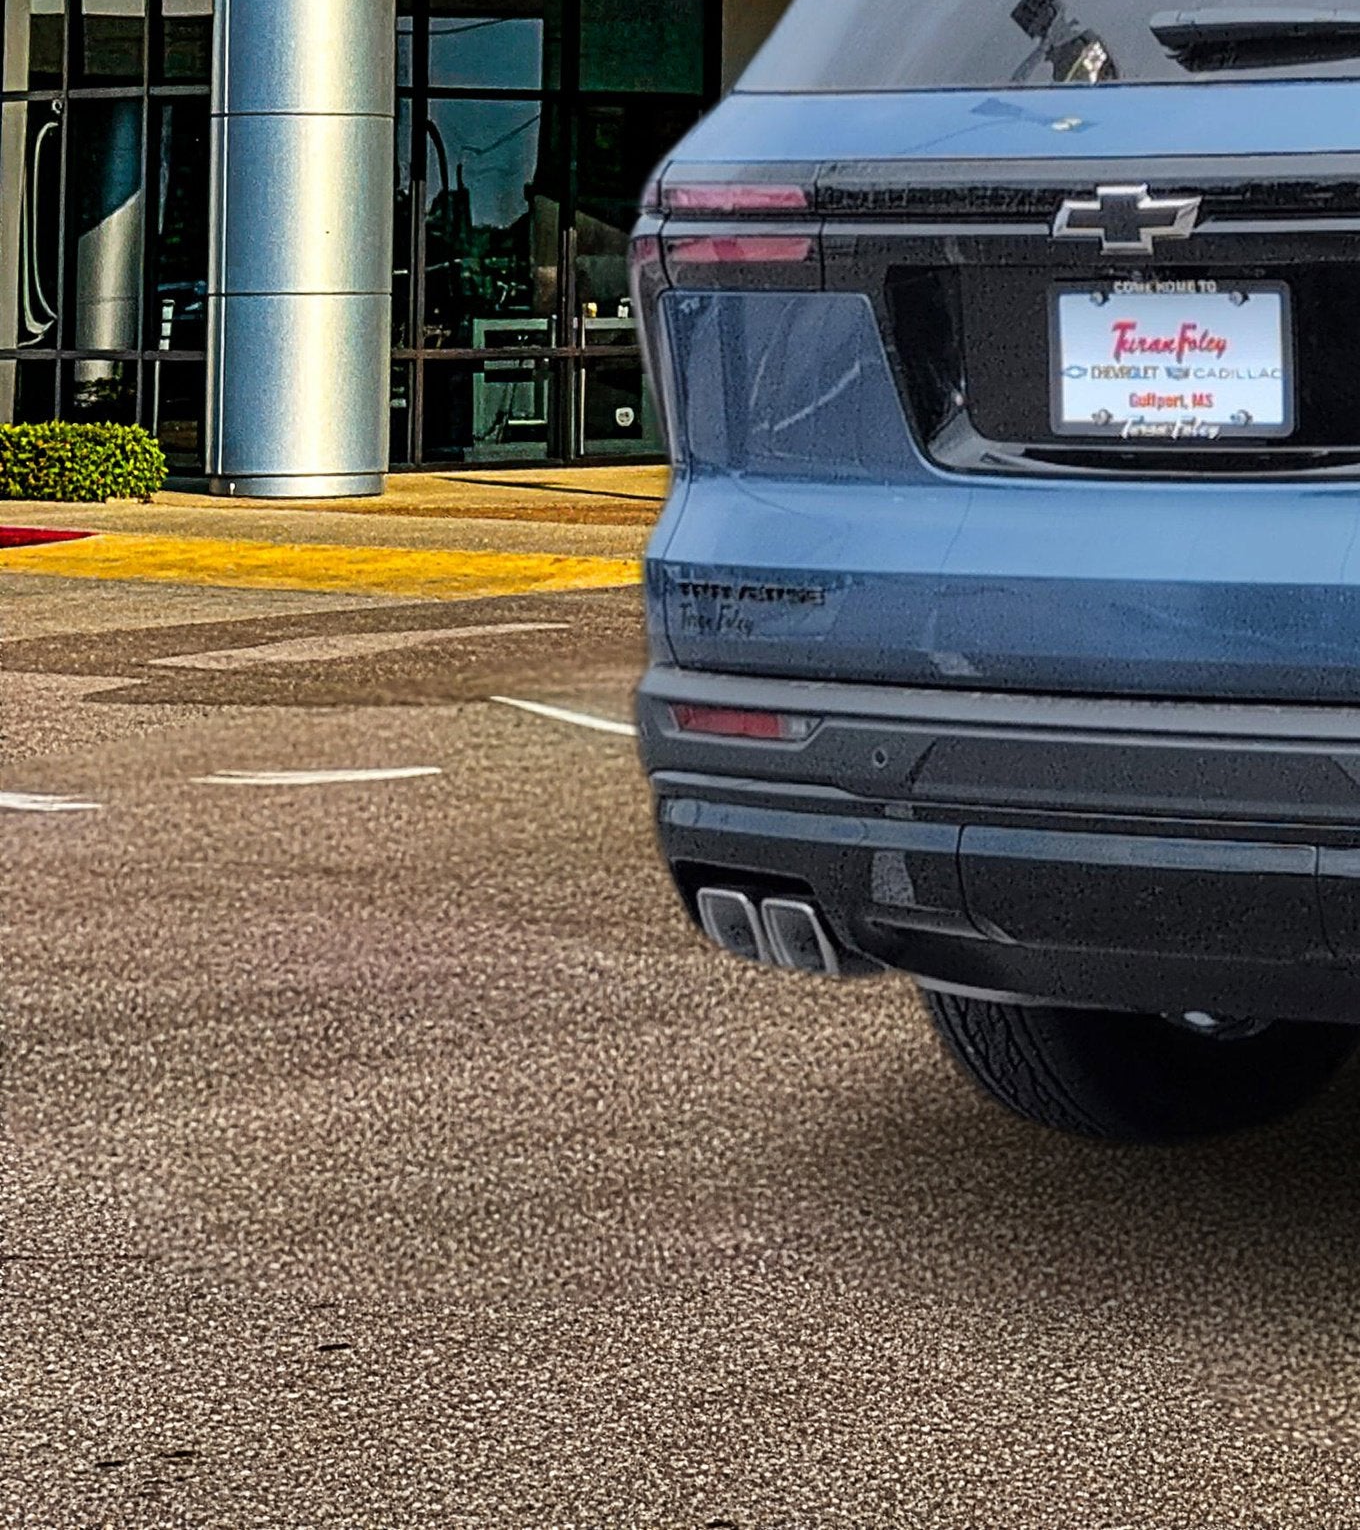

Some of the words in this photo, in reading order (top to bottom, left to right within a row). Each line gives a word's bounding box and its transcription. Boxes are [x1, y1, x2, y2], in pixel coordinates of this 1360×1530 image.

[1091, 366, 1159, 379] CHEVROLET
[1193, 368, 1281, 380] CADILLAC
[1129, 393, 1188, 410] Gulfport,
[1192, 393, 1213, 408] MS
